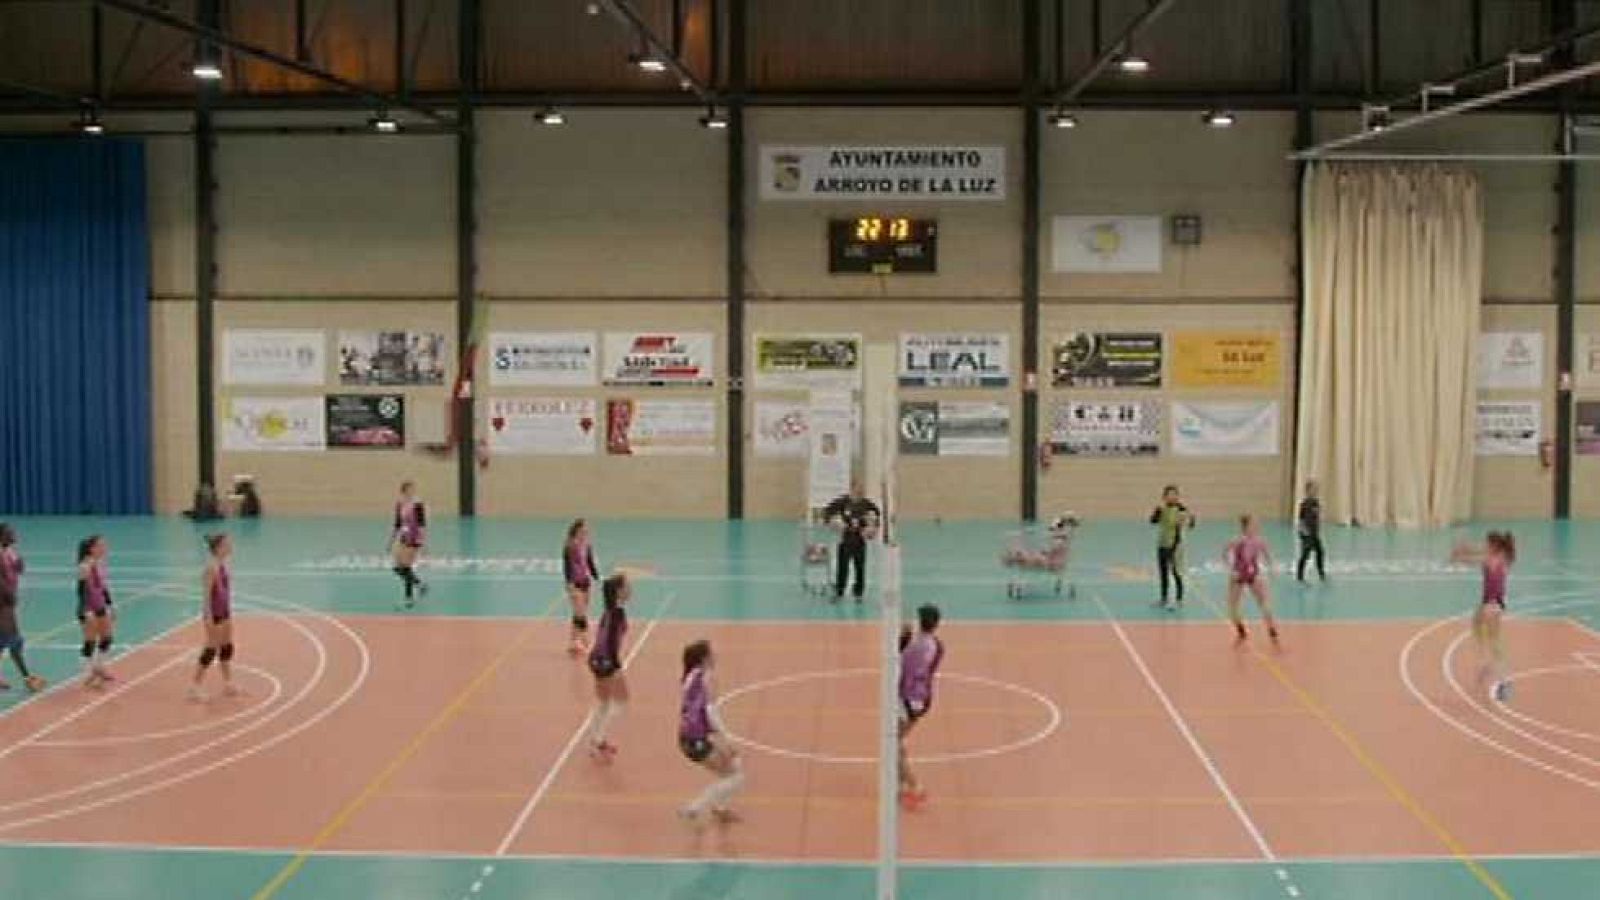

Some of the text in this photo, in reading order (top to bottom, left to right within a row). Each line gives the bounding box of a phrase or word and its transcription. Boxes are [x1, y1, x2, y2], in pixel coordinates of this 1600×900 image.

[829, 151, 981, 168] AYUNTAMIENTO
[814, 178, 996, 194] ARROYO DE LA LUZ
[907, 352, 1000, 370] LEAL
